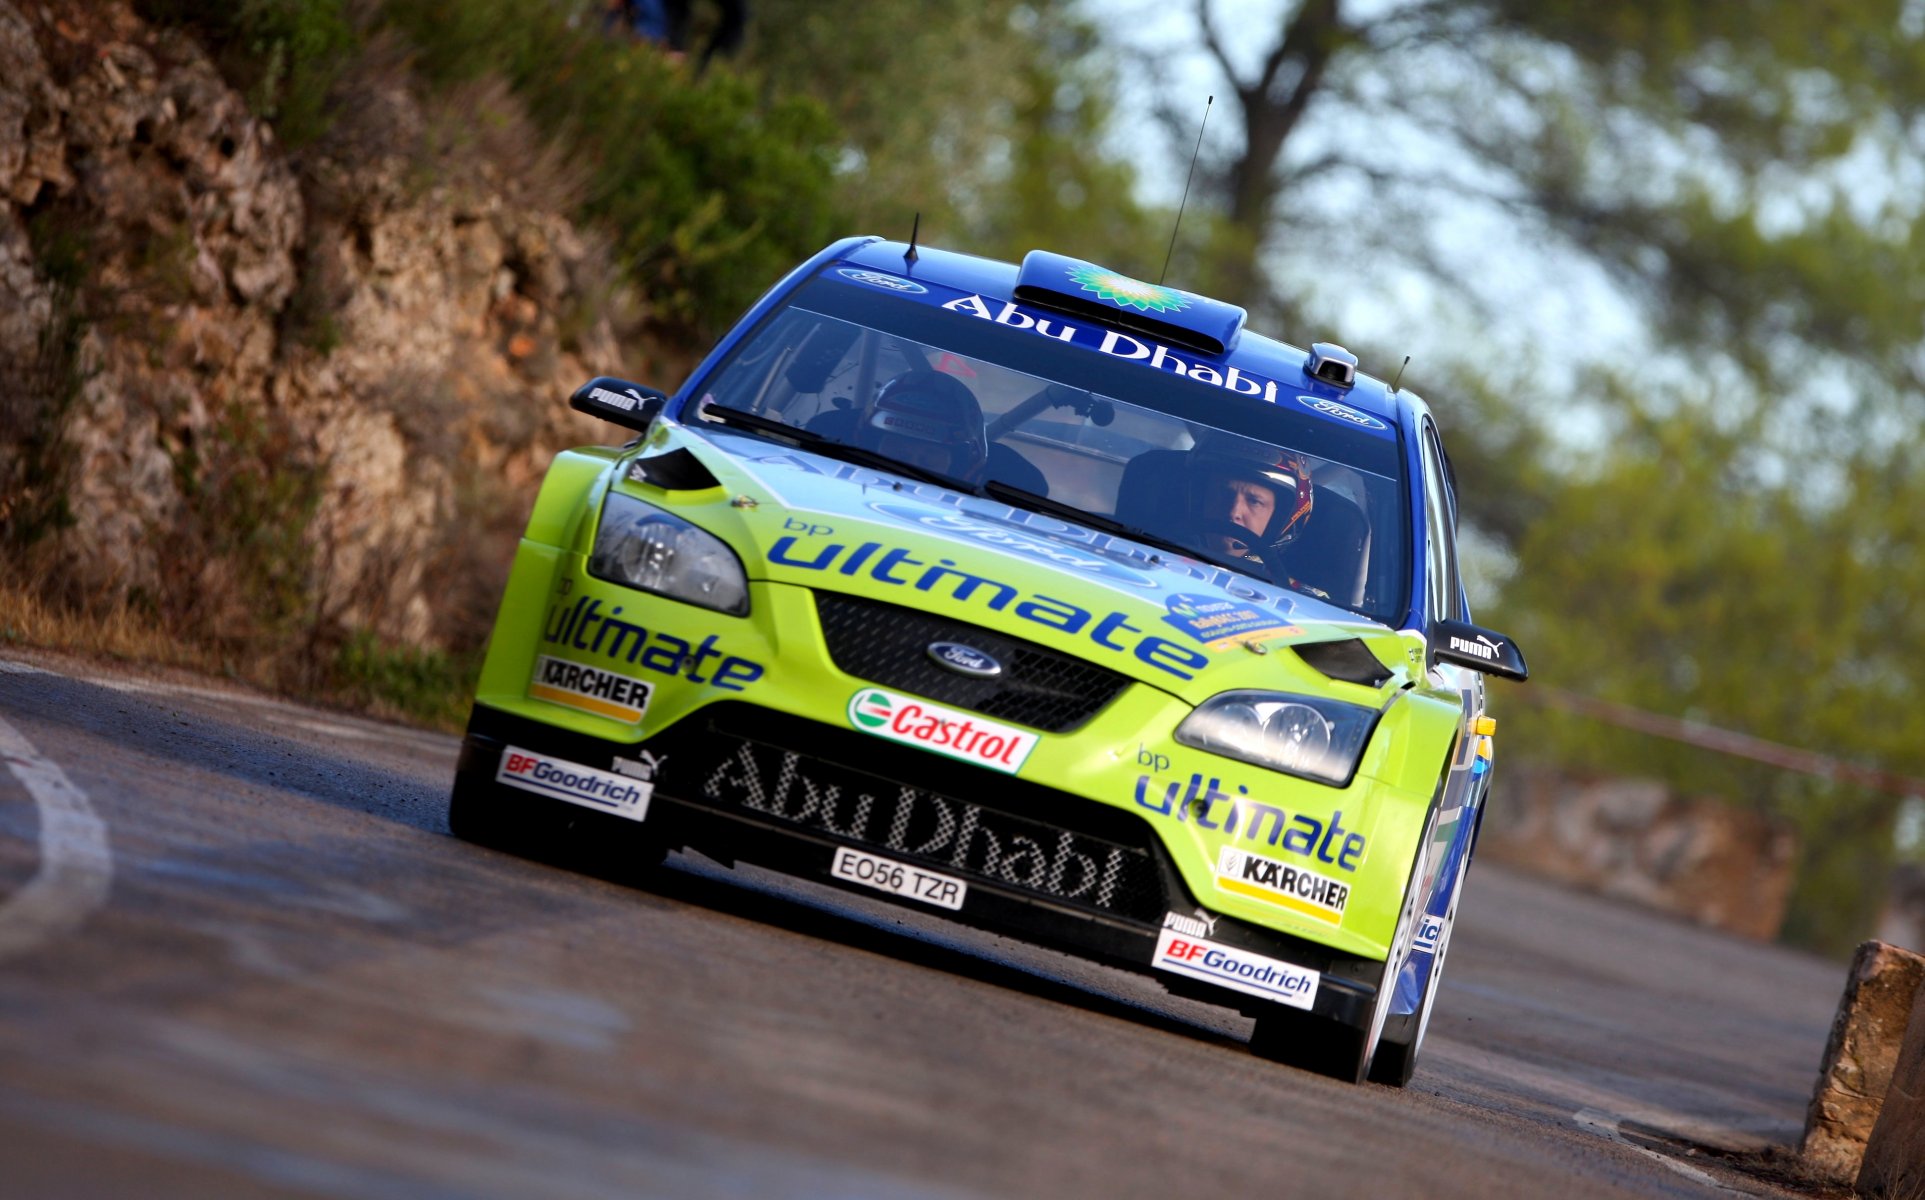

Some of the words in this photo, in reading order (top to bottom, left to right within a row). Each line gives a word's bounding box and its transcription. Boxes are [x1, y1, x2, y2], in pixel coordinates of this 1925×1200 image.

[852, 272, 912, 290] Ford
[941, 293, 1077, 343] Abu
[1099, 330, 1278, 403] Dhabi
[588, 387, 638, 411] PUMA
[1313, 400, 1370, 426] Ford
[783, 517, 834, 536] bp
[919, 506, 1109, 572] Ford
[766, 536, 1210, 682] ultimate
[544, 596, 765, 692] ultimate
[944, 647, 984, 669] Ford
[1449, 636, 1492, 660] PUMA
[891, 704, 1022, 766] Castrol
[1136, 743, 1171, 772] bp
[505, 753, 641, 806] BFGoodrich
[703, 740, 874, 841] Abu
[886, 785, 1122, 908] Dhabi
[1134, 773, 1366, 873] ultimate
[838, 853, 904, 892] EO56
[911, 874, 961, 905] TZR
[1242, 855, 1349, 912] KÄRCHER
[1163, 911, 1208, 940] PUMA
[1165, 939, 1313, 994] BFGoodrich
